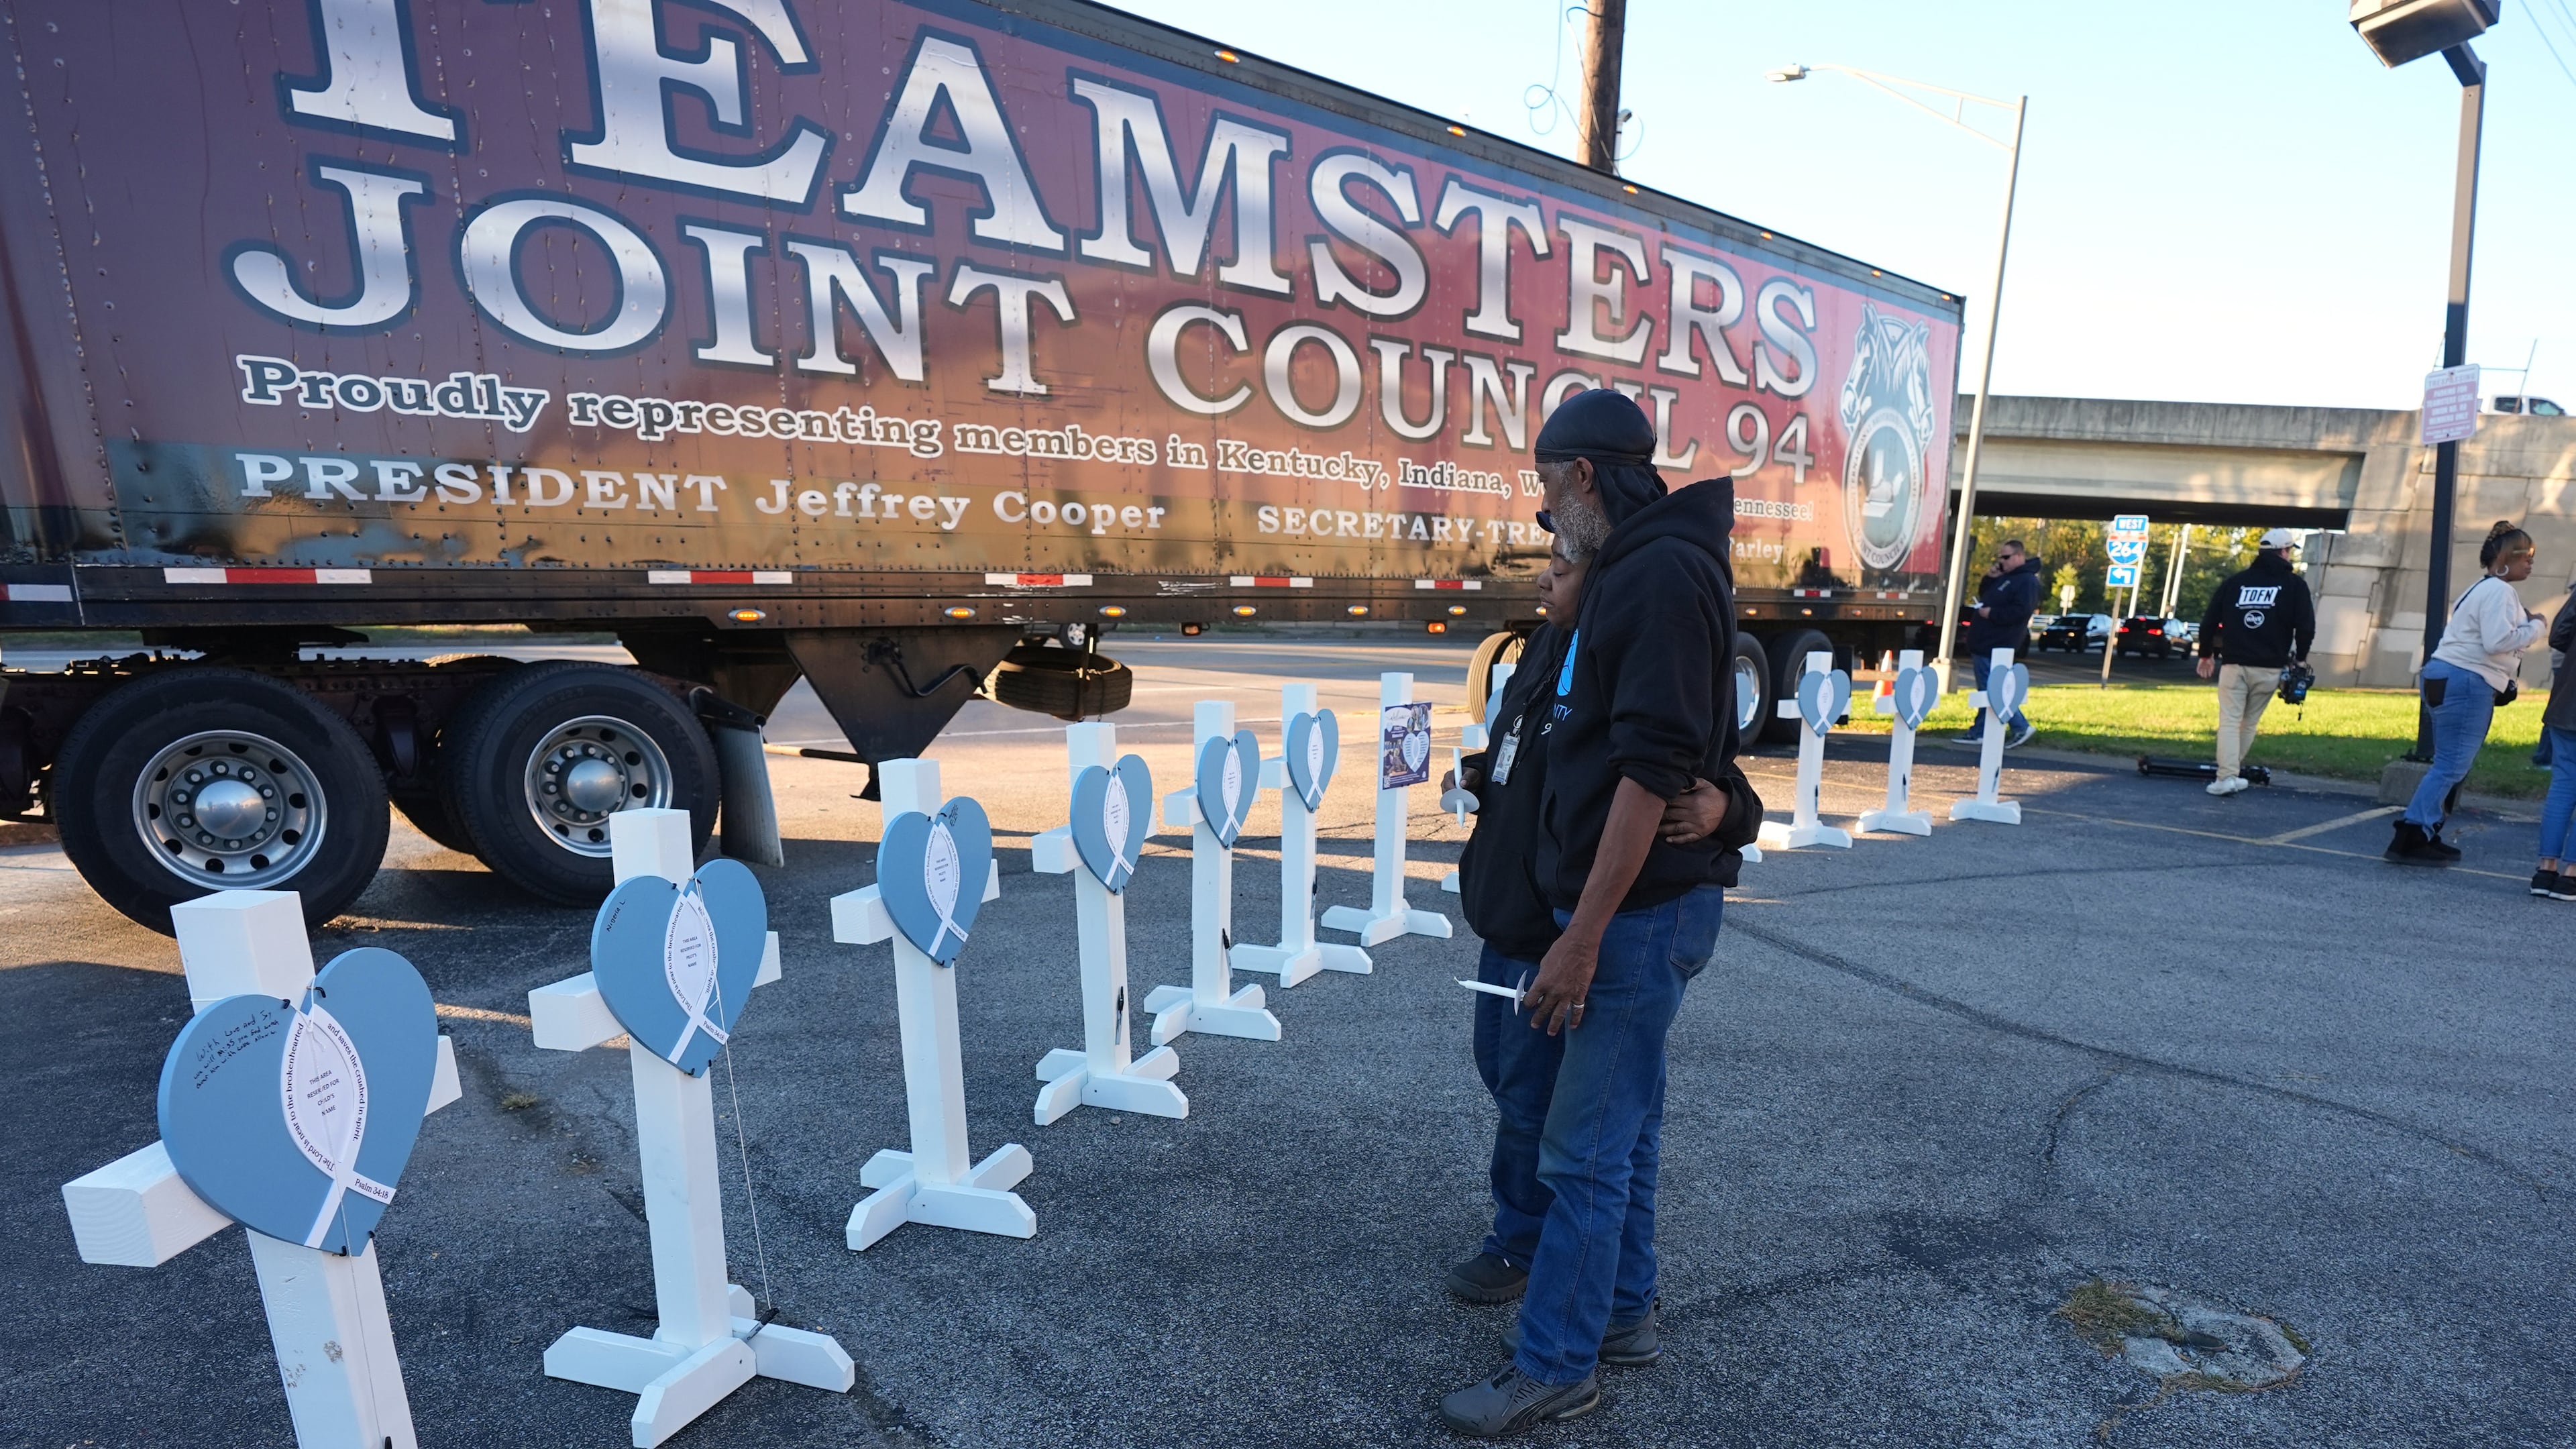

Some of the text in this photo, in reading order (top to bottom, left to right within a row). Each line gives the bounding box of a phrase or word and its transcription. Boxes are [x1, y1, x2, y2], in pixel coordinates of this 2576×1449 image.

[233, 166, 1813, 483] JOINT COUNL 94
[236, 354, 549, 433] Proudly
[568, 392, 943, 457] representing
[955, 422, 1157, 464] members
[1167, 434, 1208, 470] in
[1218, 439, 1389, 491] Kentucky,
[1399, 458, 1512, 500] Indiana,
[1733, 498, 1814, 522] ennessee!
[235, 453, 727, 512] PRESIDENT
[756, 479, 970, 530] Jeffrey
[993, 490, 1165, 534] Cooper
[1258, 506, 1554, 546] SECRETARY-TRE
[2118, 519, 2144, 529] WEST
[2111, 541, 2143, 557] 264
[2243, 589, 2274, 602] TDFN
[196, 1038, 220, 1062] With
[309, 1070, 333, 1085] THIS AREA
[327, 1022, 366, 1142] and saves the crushed in spirit.
[329, 1078, 340, 1087] FOR
[285, 1022, 335, 1172] The Lord is near to the brokenhearted
[354, 1178, 390, 1200] Psalm 34:18
